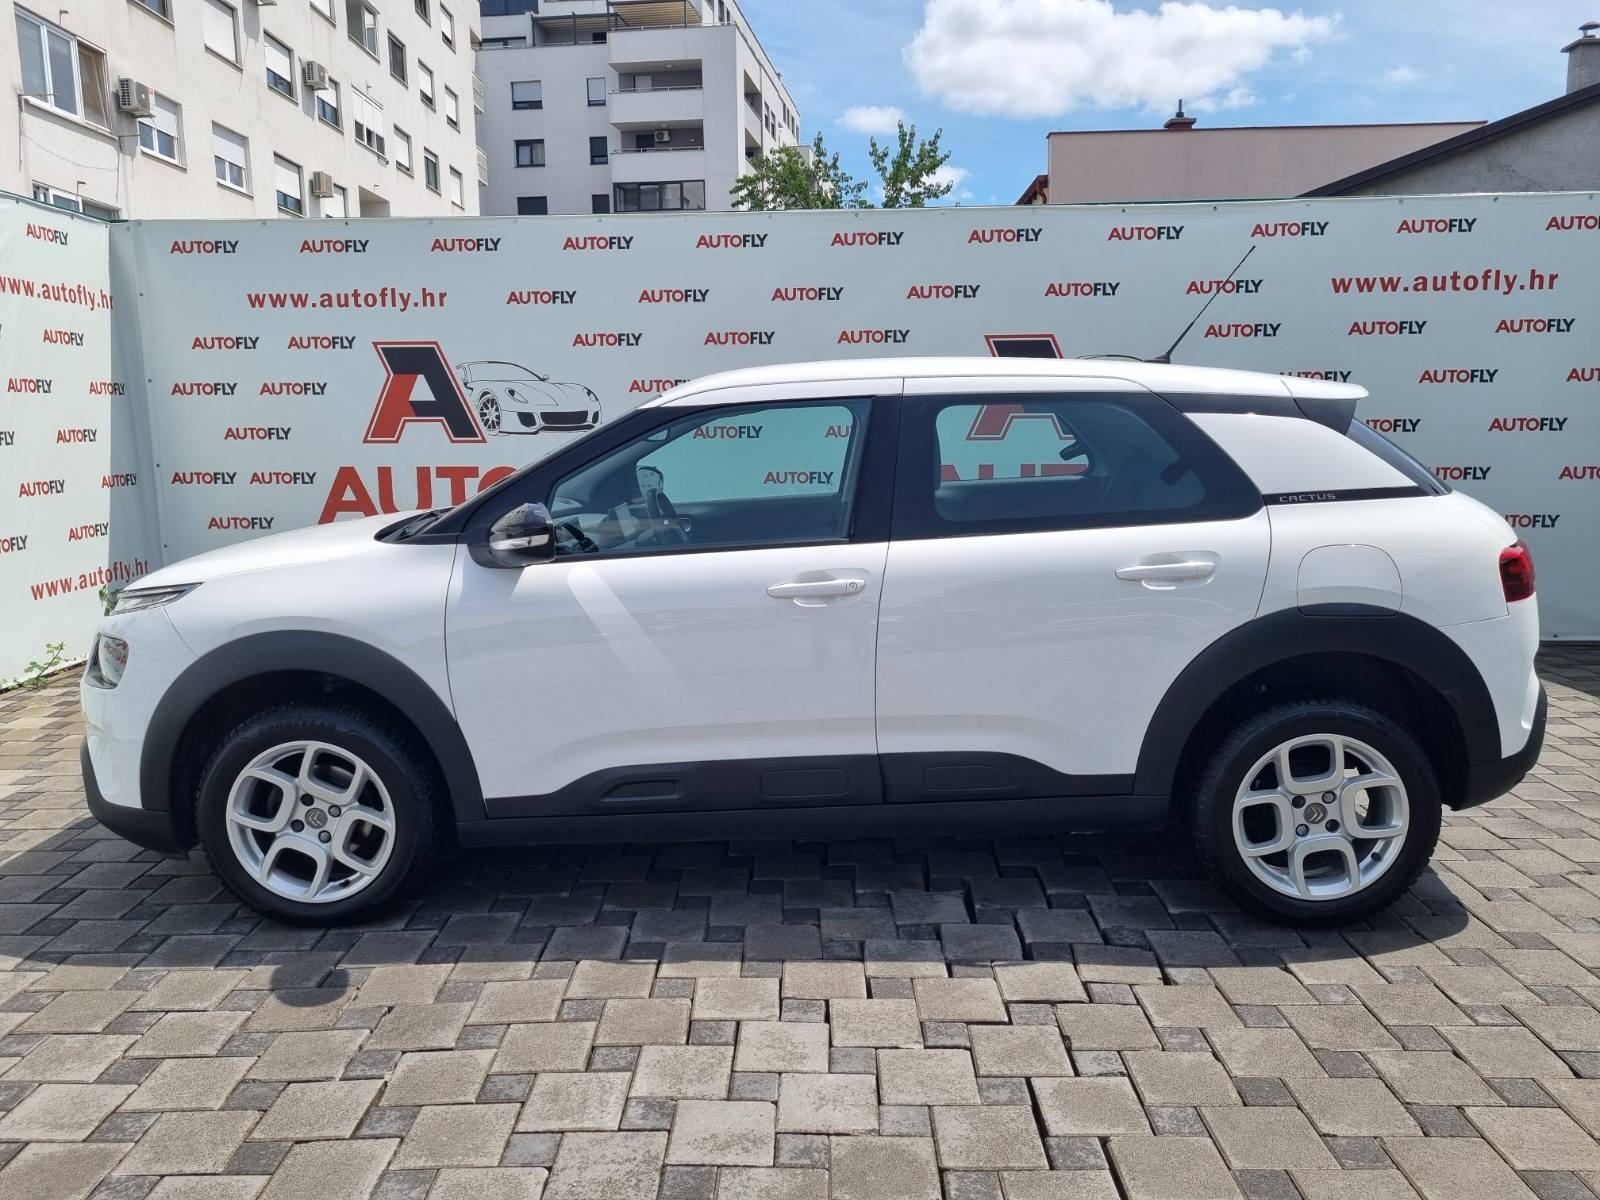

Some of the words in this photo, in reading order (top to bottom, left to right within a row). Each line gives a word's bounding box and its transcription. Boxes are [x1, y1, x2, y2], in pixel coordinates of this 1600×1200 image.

[1251, 222, 1329, 237] AUTOFLY
[1397, 218, 1477, 233] AUTOFLY
[1545, 216, 1600, 230] AUTO
[27, 223, 68, 246] AUTOFLY
[831, 232, 904, 246] AUTOFLY
[968, 228, 1042, 243] AUTOFLY
[1108, 226, 1184, 240] AUTOFLY
[171, 241, 238, 253] AUTOFLY
[300, 240, 369, 253] AUTOFLY
[431, 238, 501, 251] AUTOFLY
[563, 236, 633, 250] AUTOFLY
[696, 234, 768, 248] AUTOFLY
[1045, 282, 1120, 296] AUTOFLY
[1186, 279, 1263, 294] AUTOFLY
[1332, 269, 1558, 295] www.autofly.hr
[507, 291, 576, 304] AUTOFLY
[639, 289, 709, 303] AUTOFLY
[772, 287, 844, 301] AUTOFLY
[907, 285, 980, 299] AUTOFLY
[247, 288, 447, 312] www.autofly.hr
[1204, 323, 1281, 338] AUTOFLY
[1348, 321, 1427, 335] AUTOFLY
[1496, 318, 1575, 333] AUTOFLY
[44, 329, 83, 346] AUTOFLY
[192, 337, 259, 349] AUTOFLY
[288, 336, 356, 349] AUTOFLY
[573, 333, 642, 346] AUTOFLY
[704, 332, 775, 345] AUTOFLY
[838, 330, 910, 343] AUTOFLY
[1419, 369, 1498, 383] AUTOFLY
[8, 378, 52, 393] AUTOFLY
[89, 382, 125, 395] AUTOFLY
[171, 383, 237, 395] AUTOFLY
[260, 383, 327, 395] AUTOFLY
[1488, 418, 1568, 431] AUTOFLY
[57, 429, 97, 443] AUTOFLY
[224, 427, 291, 440] AUTOFLY
[693, 426, 763, 439] AUTOFLY
[101, 473, 137, 488] AUTOFLY
[171, 472, 237, 484] AUTOFLY
[250, 472, 316, 484] AUTOFLY
[764, 472, 834, 485] AUTOFLY
[19, 480, 64, 497] AUTOFLY
[1279, 493, 1336, 503] CACTUS
[208, 517, 274, 529] AUTOFLY
[68, 522, 109, 541] AUTOFLY
[0, 535, 27, 552] OFLY
[31, 558, 149, 600] www.autofly.hr
